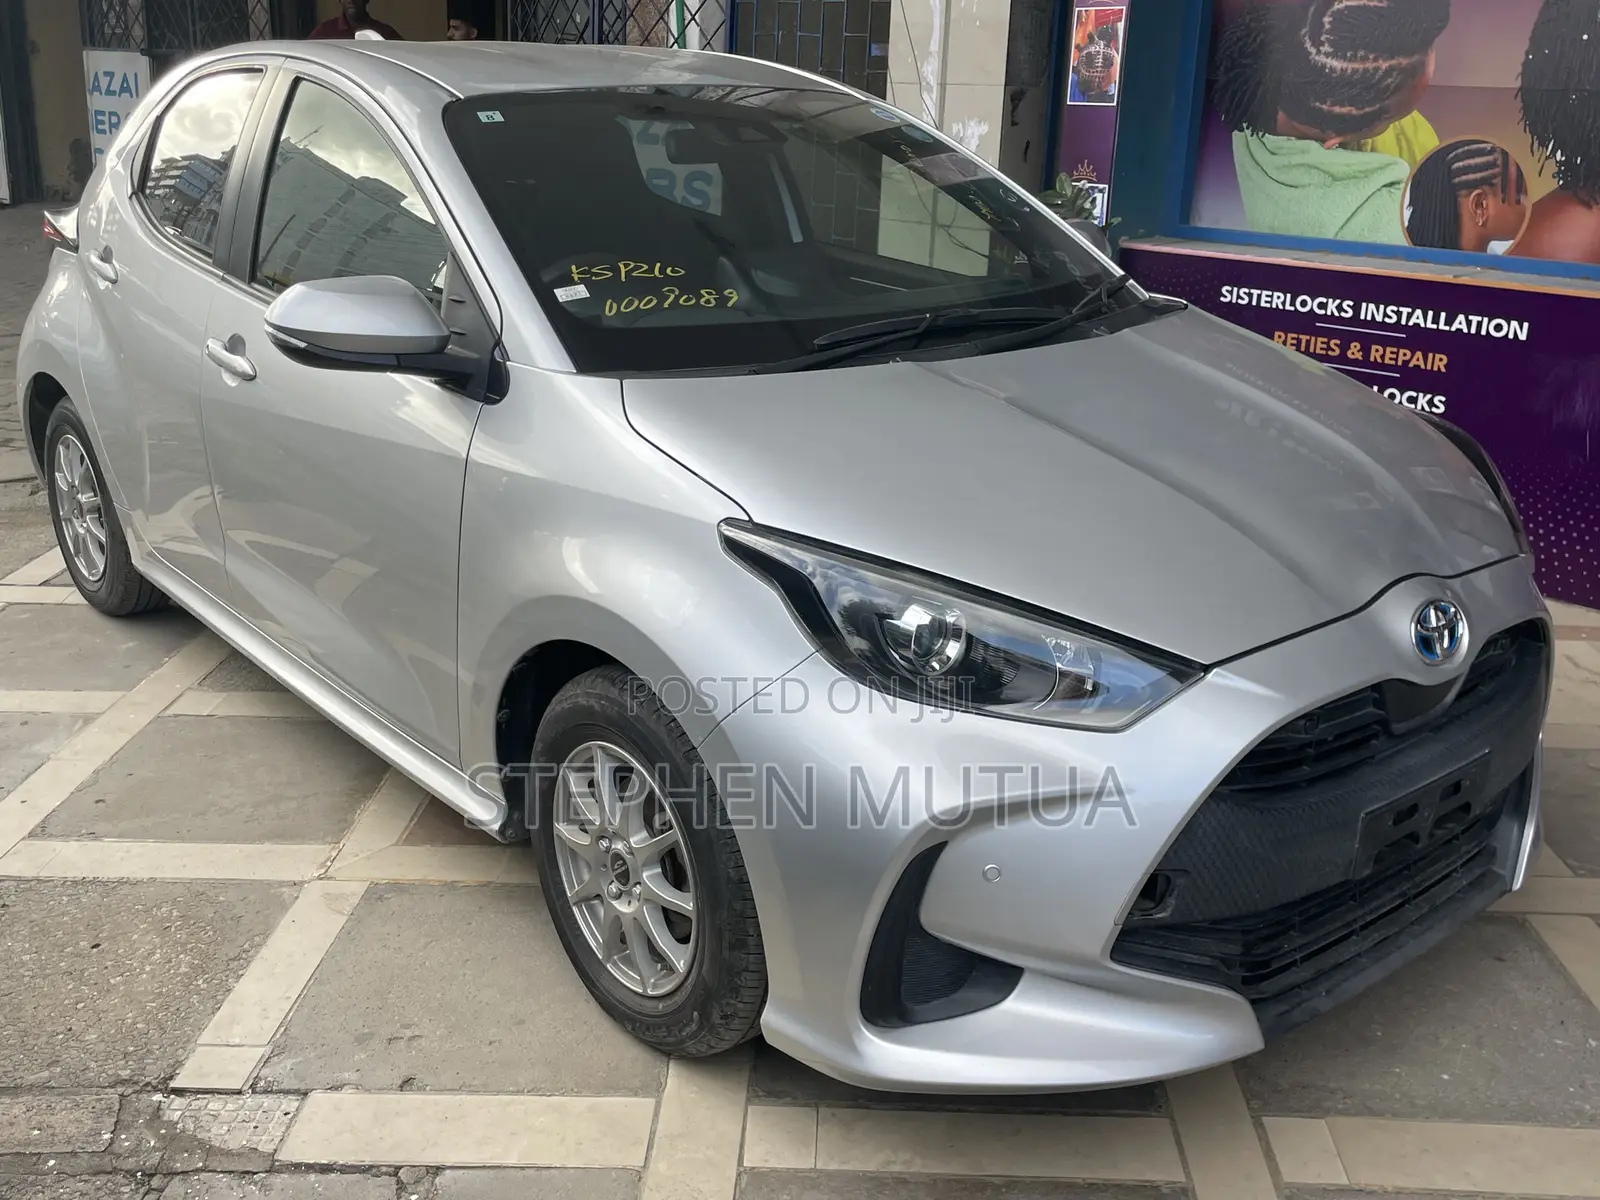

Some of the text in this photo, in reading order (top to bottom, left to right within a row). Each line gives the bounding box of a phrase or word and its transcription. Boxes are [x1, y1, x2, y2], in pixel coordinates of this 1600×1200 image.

[88, 71, 139, 98] AZAI
[571, 261, 686, 282] KSP210
[1220, 285, 1530, 341] SISTERLOCKS INSTALLATION
[1273, 331, 1448, 373] RETIES & REPAIR
